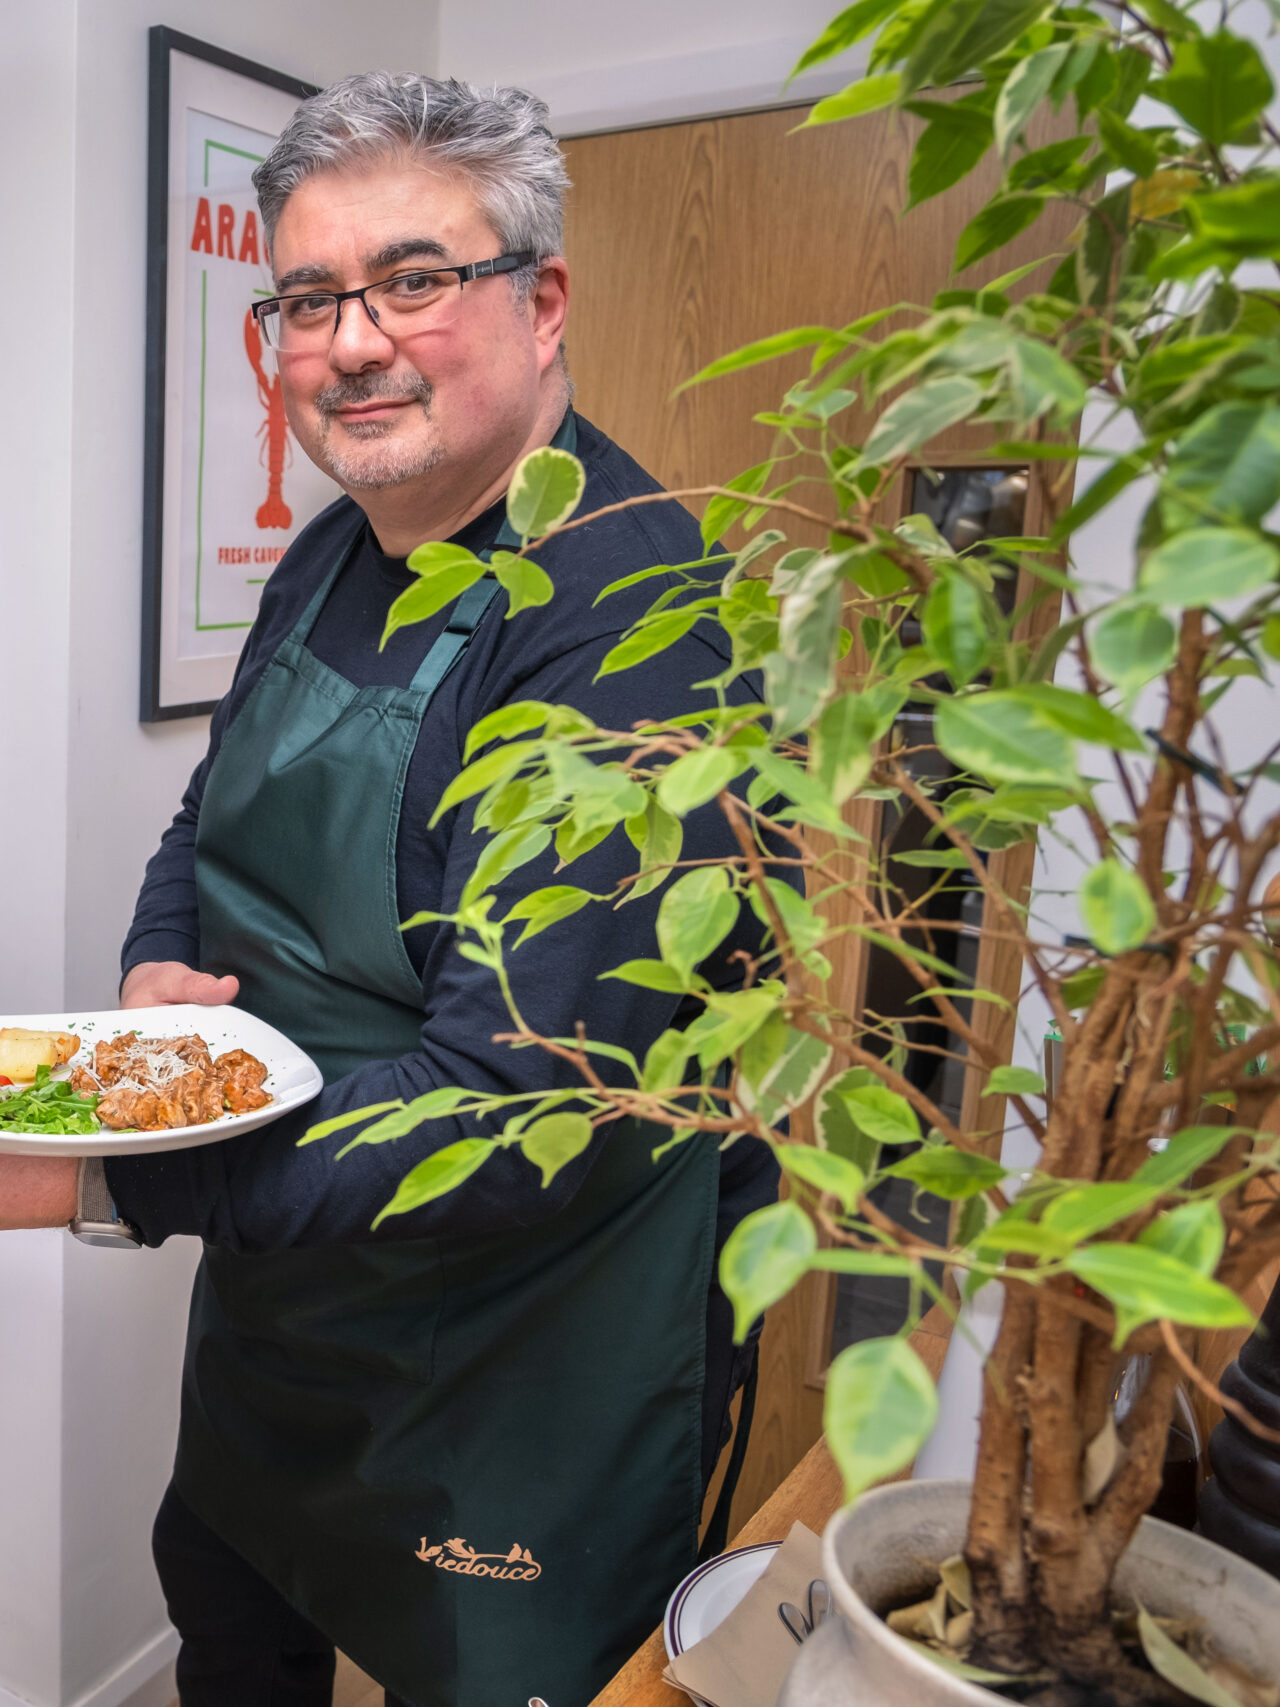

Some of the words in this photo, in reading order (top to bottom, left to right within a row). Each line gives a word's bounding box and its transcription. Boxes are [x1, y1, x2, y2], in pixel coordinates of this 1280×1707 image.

[190, 196, 271, 266] ARA
[218, 546, 251, 565] FRESH
[415, 1536, 542, 1582] Viedouce
